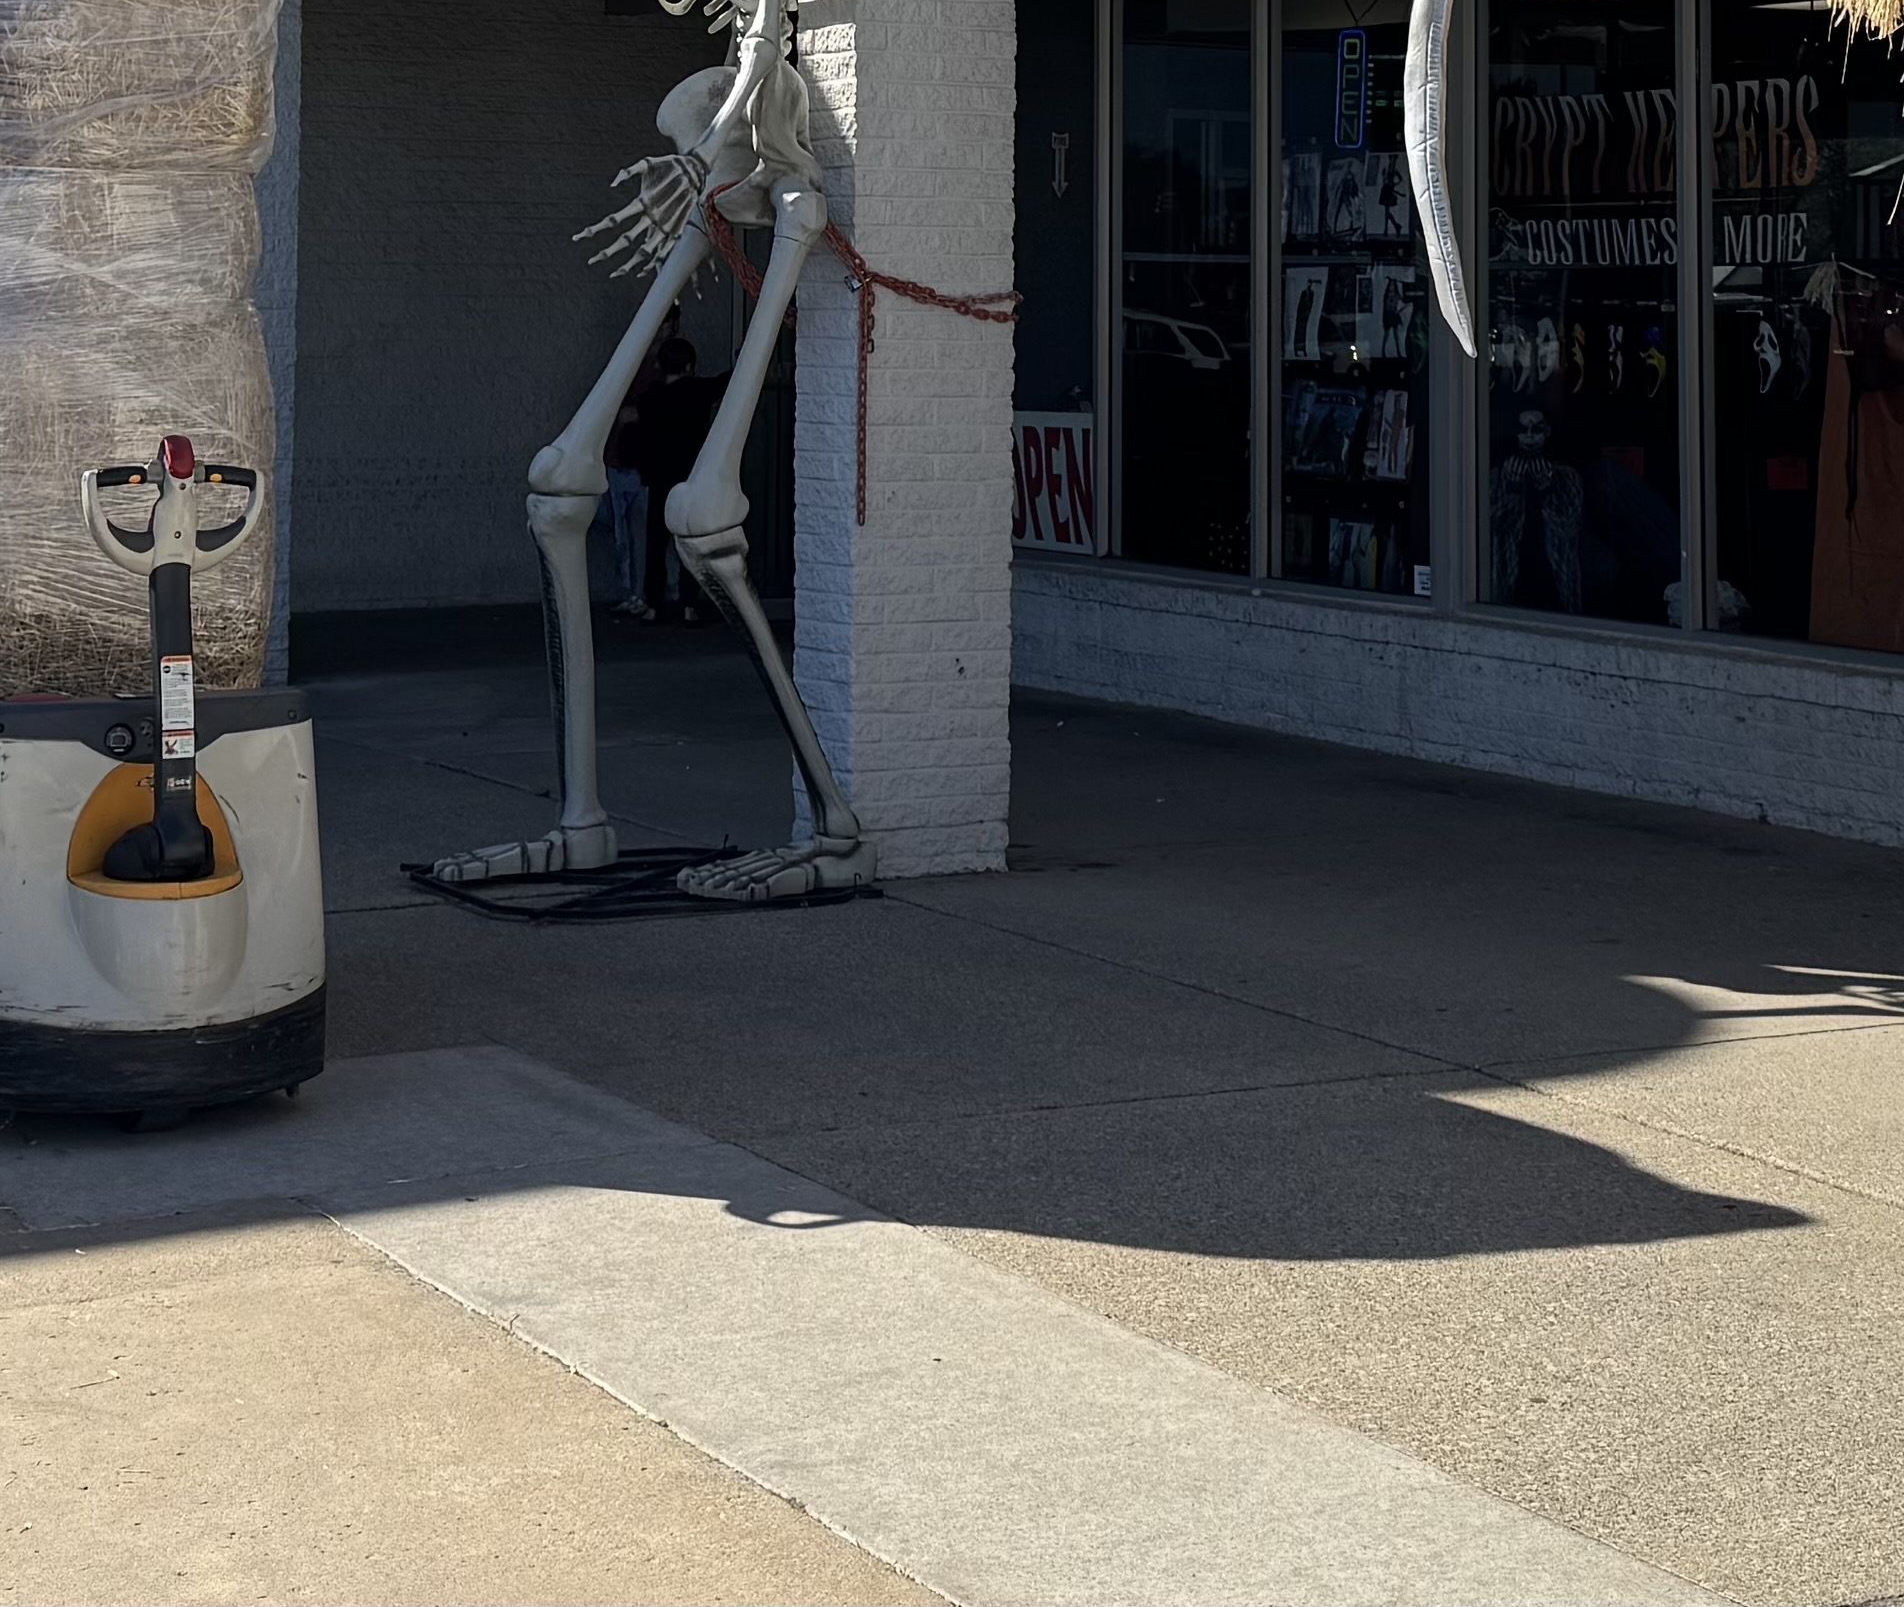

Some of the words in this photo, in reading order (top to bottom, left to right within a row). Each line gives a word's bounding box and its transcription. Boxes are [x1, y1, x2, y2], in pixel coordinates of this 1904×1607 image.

[1341, 38, 1361, 141] OPEN
[1494, 92, 1615, 195] CRYPT
[1622, 73, 1820, 194] KEPERS
[1526, 217, 1677, 267] COSTUMES
[1723, 212, 1808, 265] MORE
